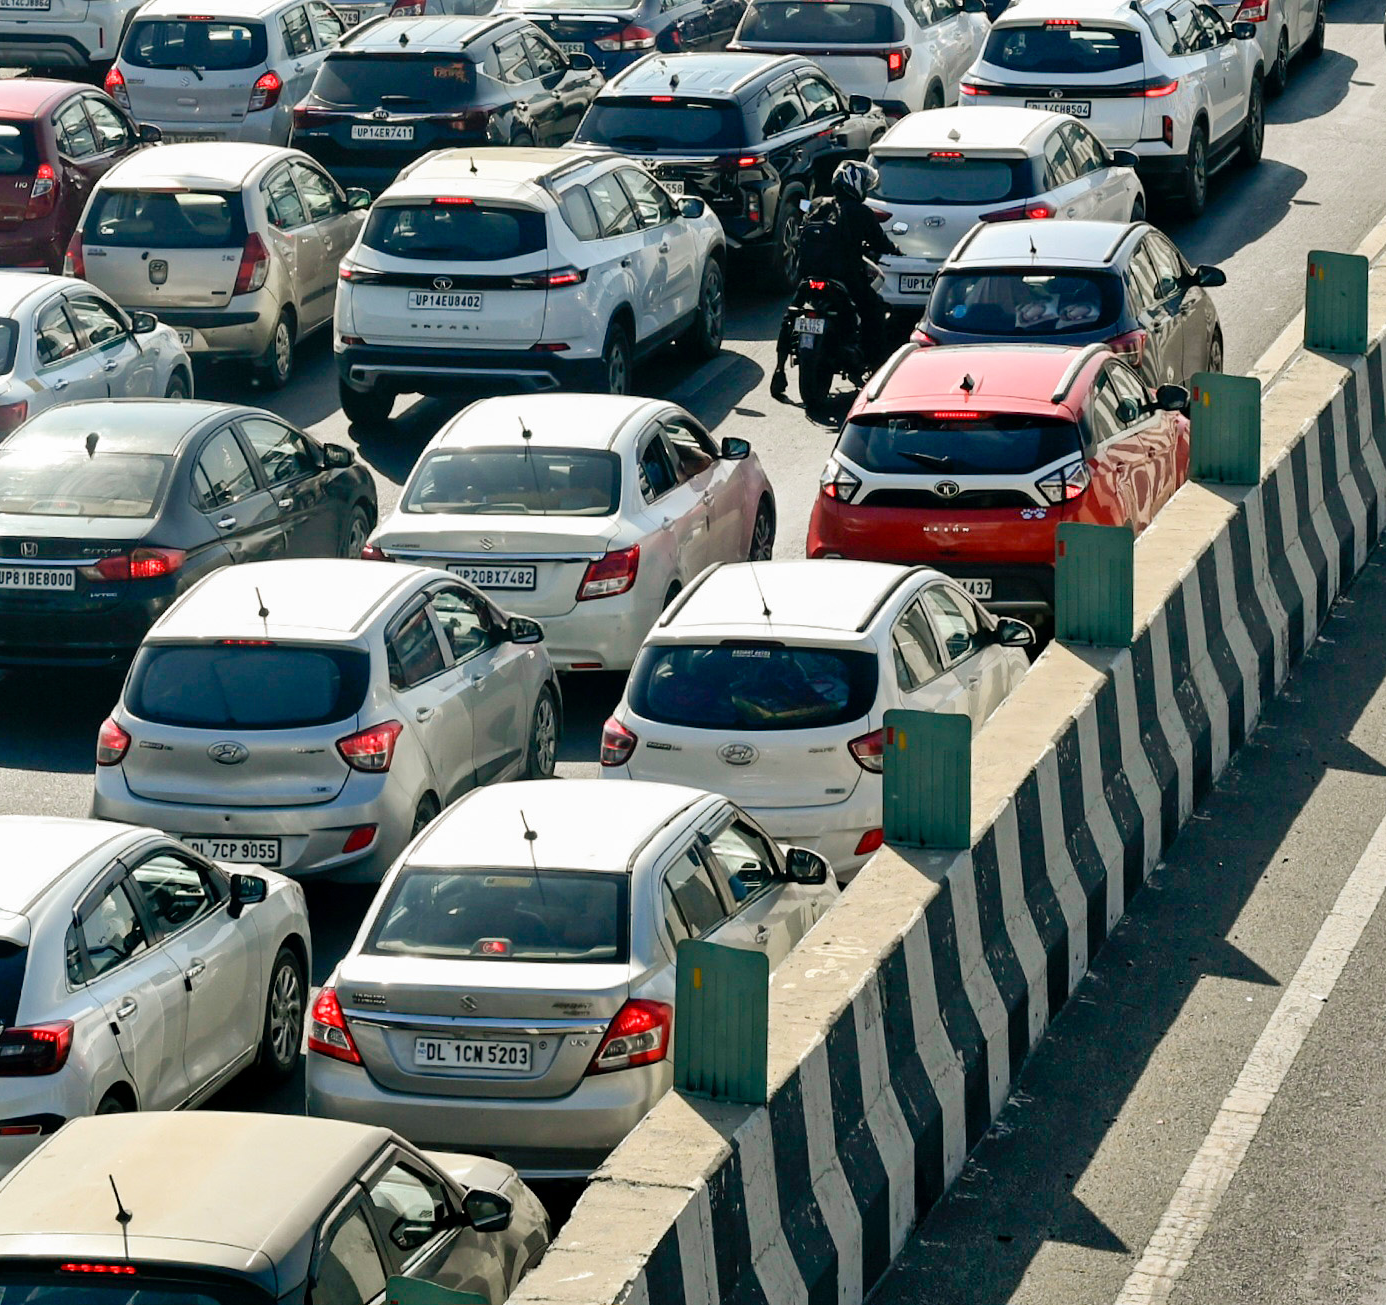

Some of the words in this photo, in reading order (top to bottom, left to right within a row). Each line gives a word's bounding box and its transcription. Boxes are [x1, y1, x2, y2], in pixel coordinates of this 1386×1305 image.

[663, 183, 683, 194] 558
[415, 294, 480, 311] UP14EU8402
[456, 568, 533, 588] UP20BX7482
[212, 842, 237, 858] 7CP
[242, 843, 276, 860] 9055
[426, 1041, 446, 1062] DL
[455, 1042, 483, 1063] 1CN
[488, 1043, 528, 1065] 5203
